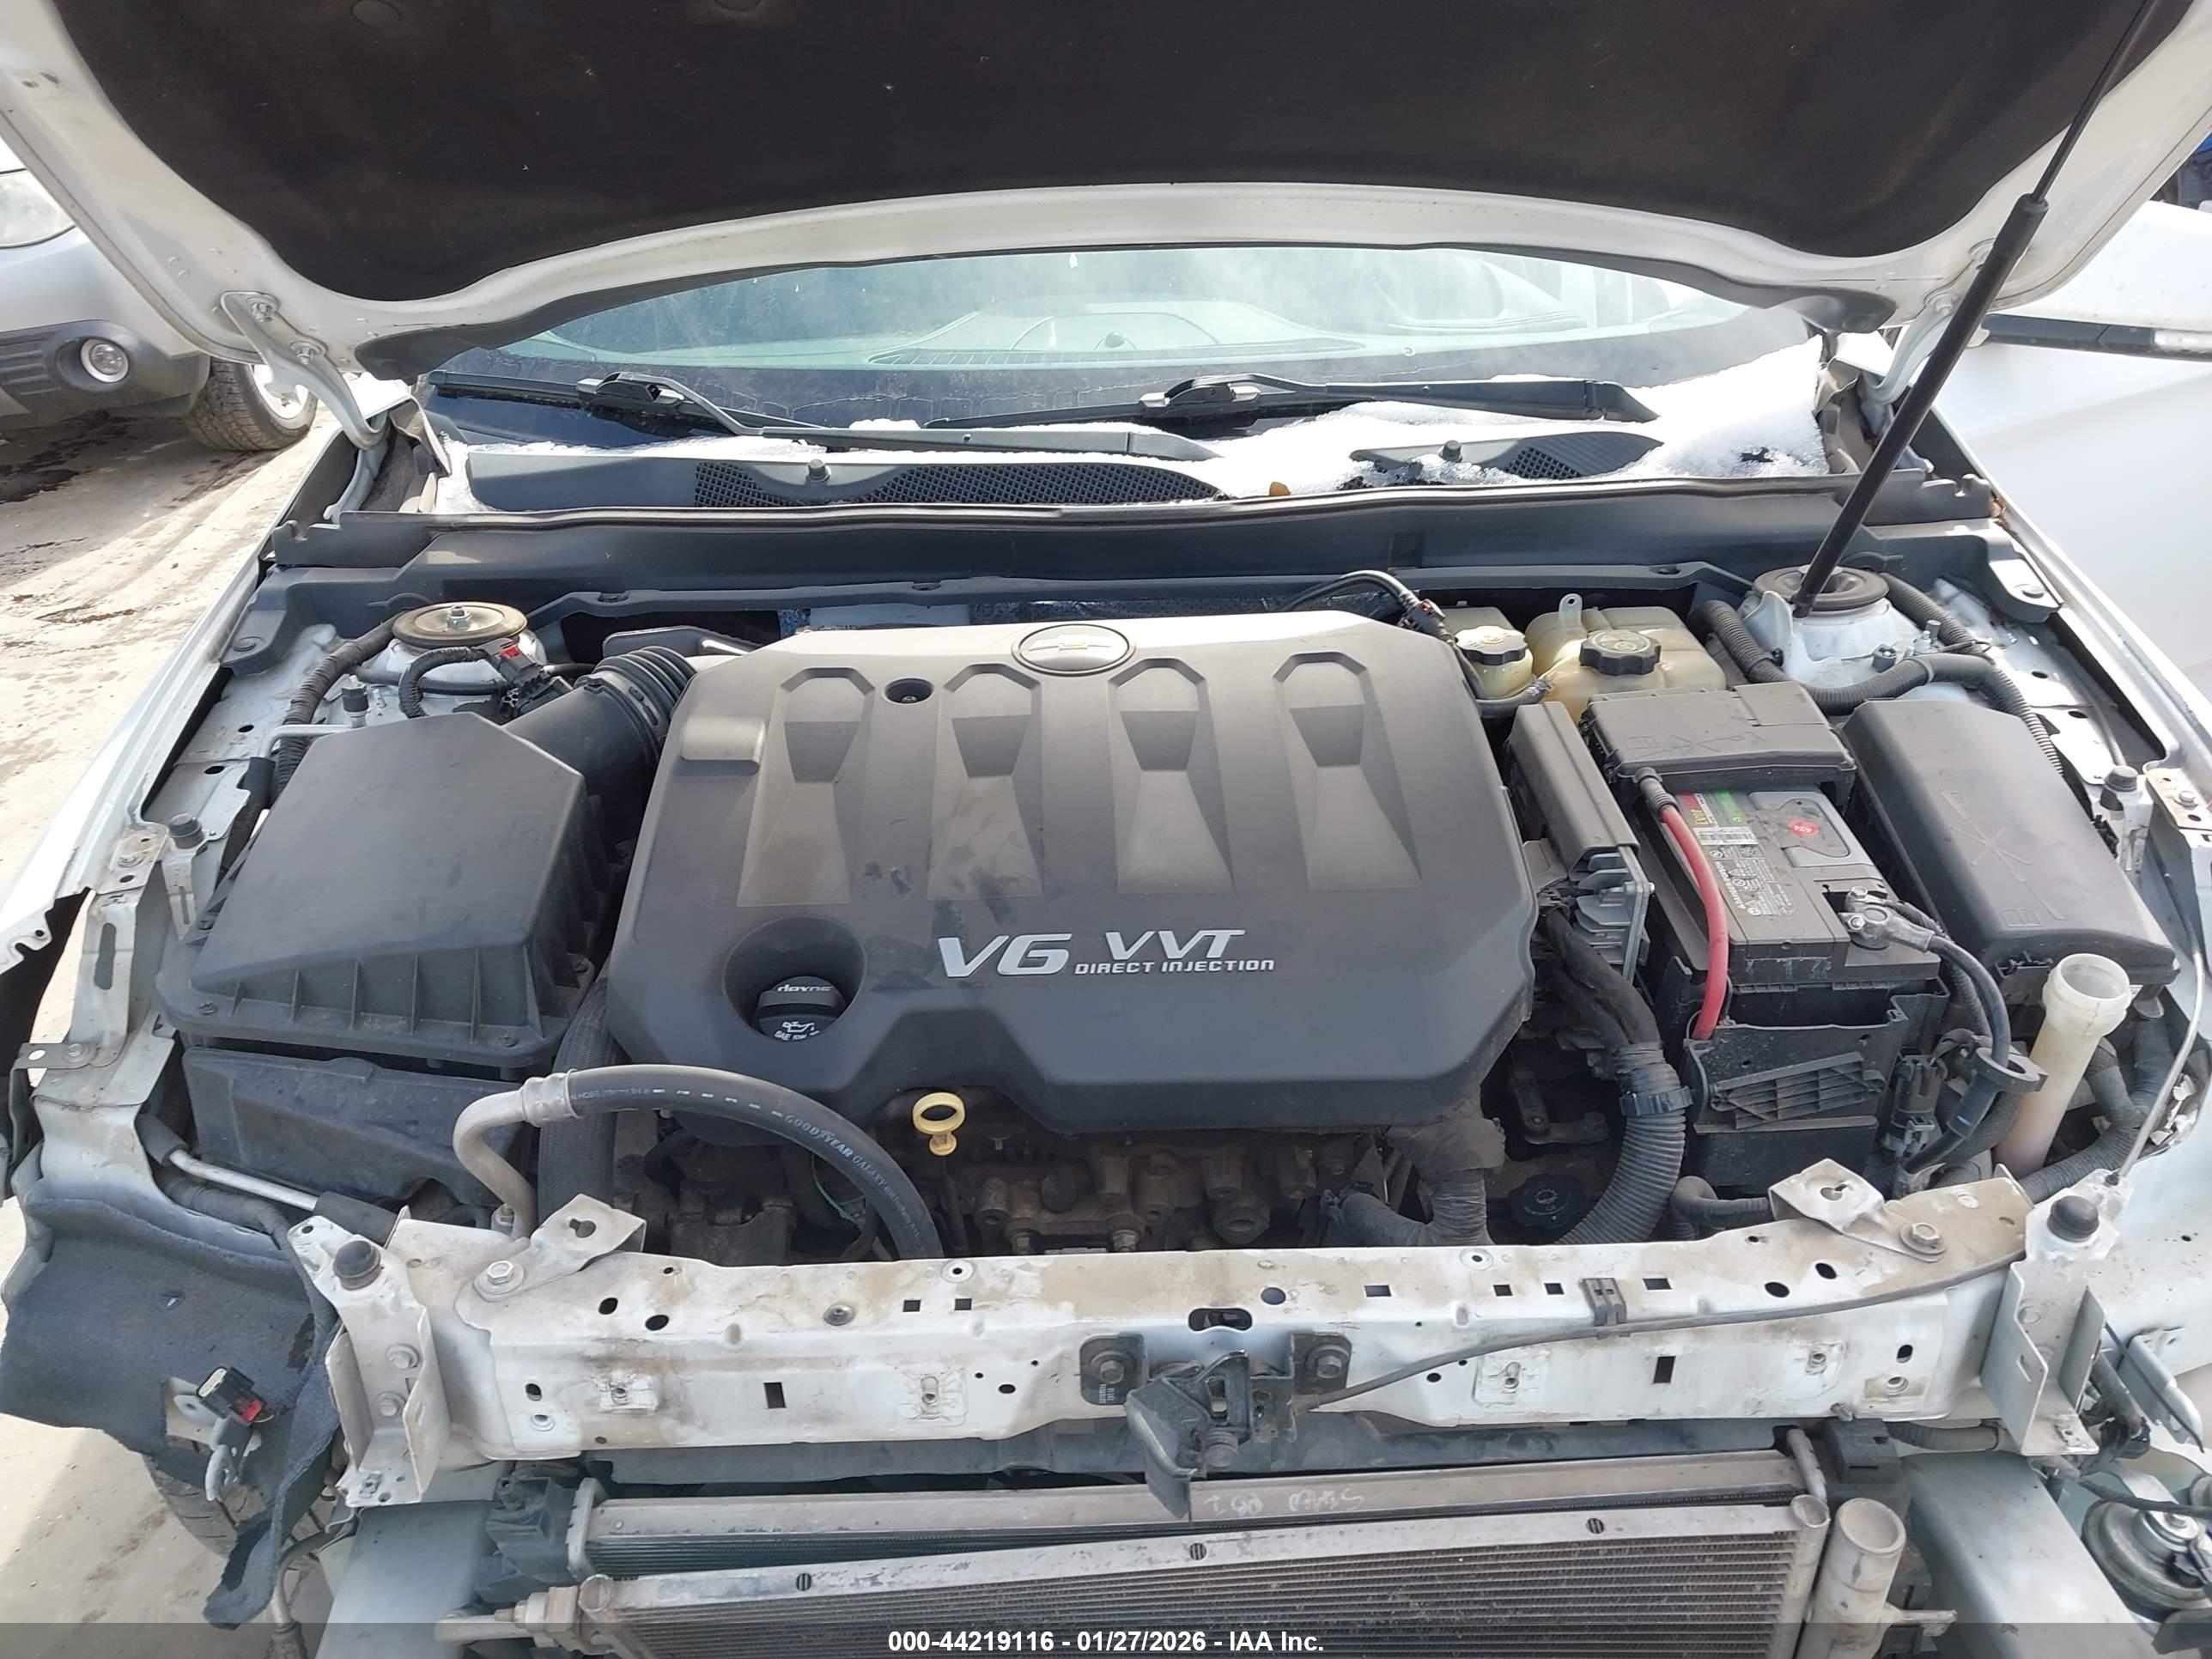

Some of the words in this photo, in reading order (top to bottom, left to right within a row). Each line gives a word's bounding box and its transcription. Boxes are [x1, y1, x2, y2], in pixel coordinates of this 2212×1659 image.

[938, 933, 1073, 977] V6
[1105, 930, 1246, 960] VVT
[1074, 961, 1155, 975] DIRECT
[1161, 959, 1274, 975] INJECTION
[785, 1115, 854, 1158] GOODYEAR
